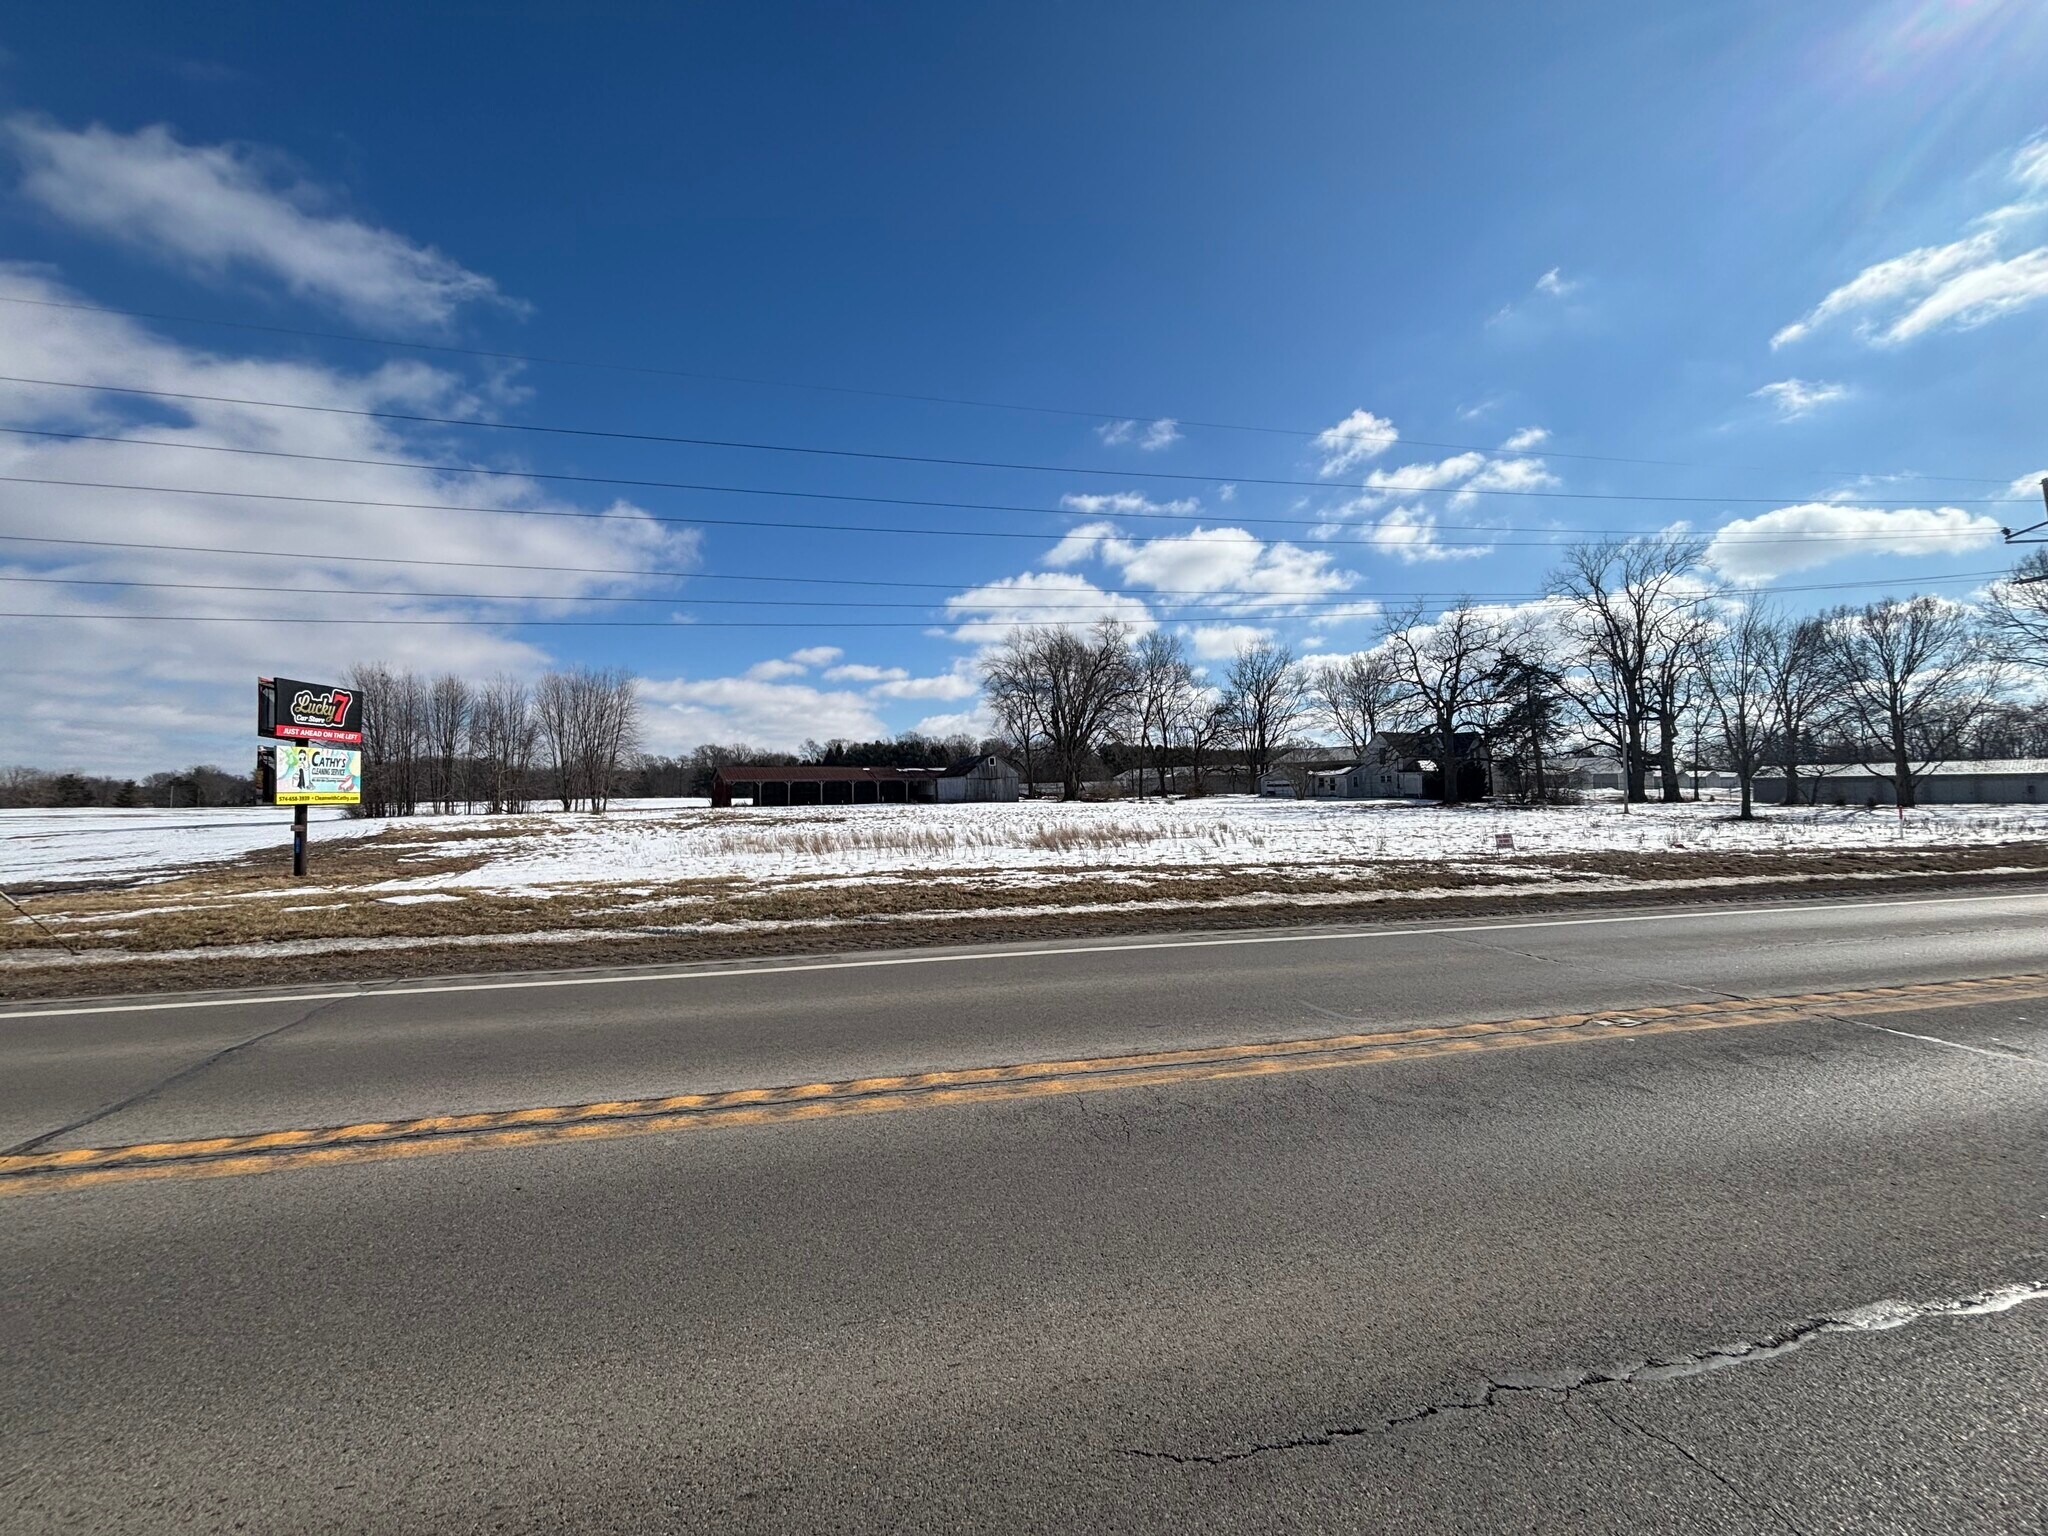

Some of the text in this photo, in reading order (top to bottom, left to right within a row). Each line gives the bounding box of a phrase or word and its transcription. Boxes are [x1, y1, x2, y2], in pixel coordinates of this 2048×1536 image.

[295, 694, 349, 722] Lucky 7
[300, 729, 322, 737] AHEAD
[311, 751, 346, 768] CATHY'S
[331, 768, 346, 776] SERVICE
